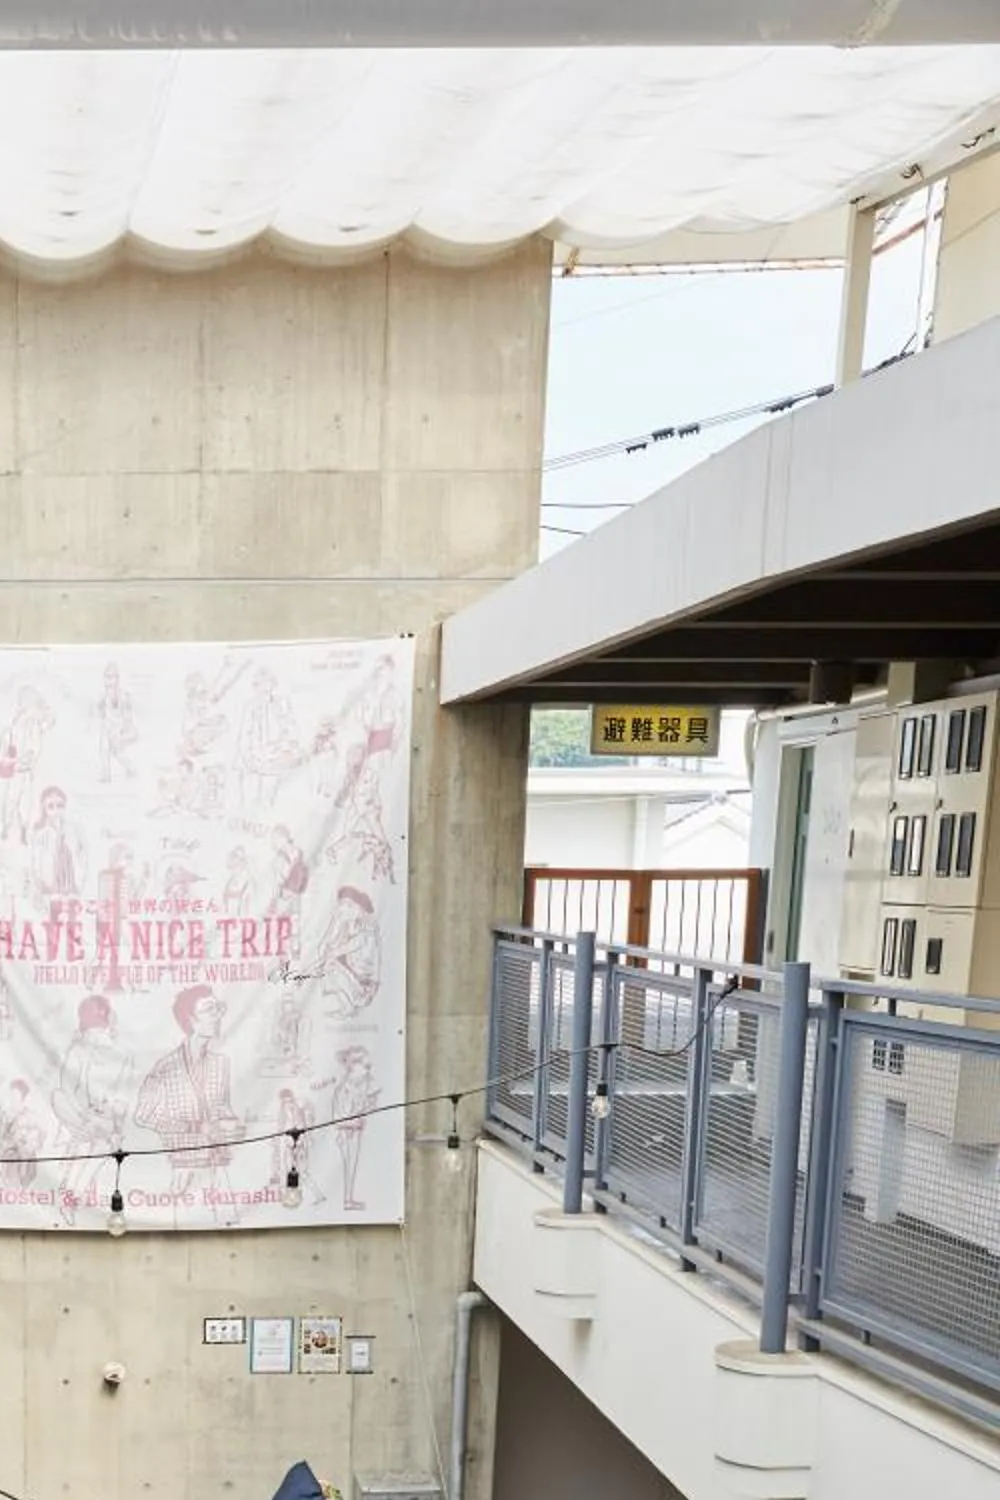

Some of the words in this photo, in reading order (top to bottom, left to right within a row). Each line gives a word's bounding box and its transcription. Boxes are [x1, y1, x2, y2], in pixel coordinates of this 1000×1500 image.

[603, 716, 709, 743] 避難器具
[97, 919, 119, 961] A
[129, 918, 206, 961] NICE
[216, 915, 294, 958] TRIP
[168, 964, 200, 983] THE
